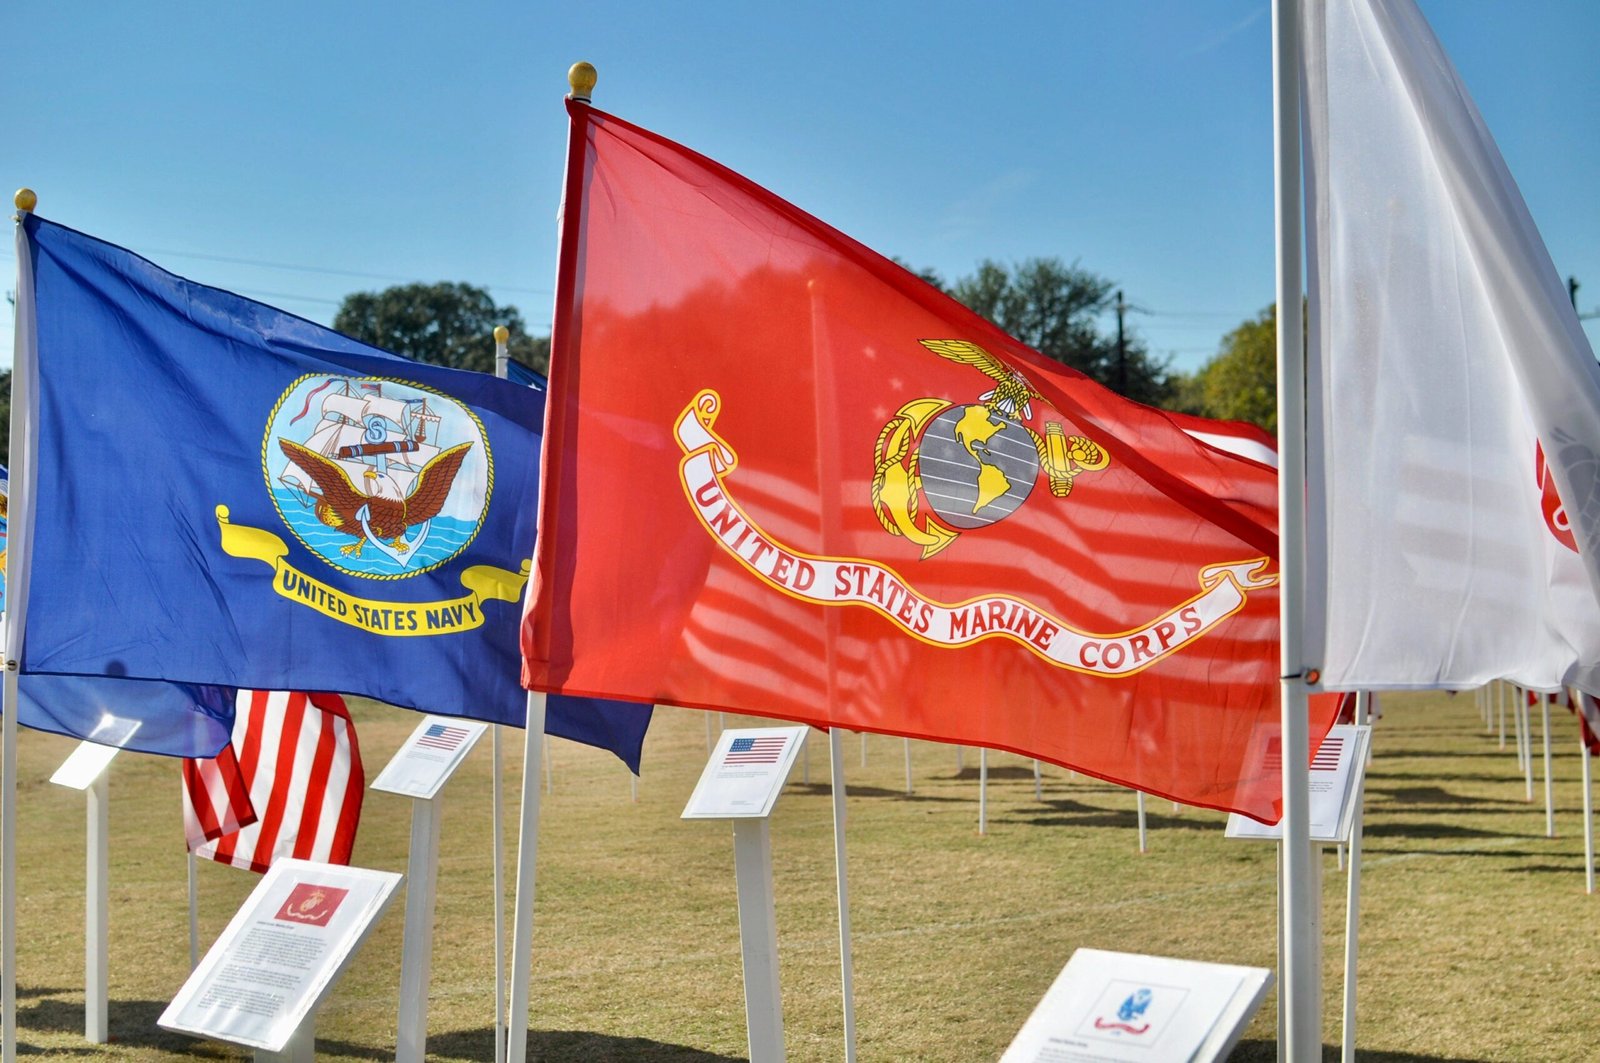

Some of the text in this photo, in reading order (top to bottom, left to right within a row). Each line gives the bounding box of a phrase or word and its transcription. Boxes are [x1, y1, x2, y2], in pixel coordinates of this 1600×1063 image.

[283, 571, 478, 630] UNITED STATES NAVY
[694, 475, 1202, 669] UNITED STATES MARINE CORPS
